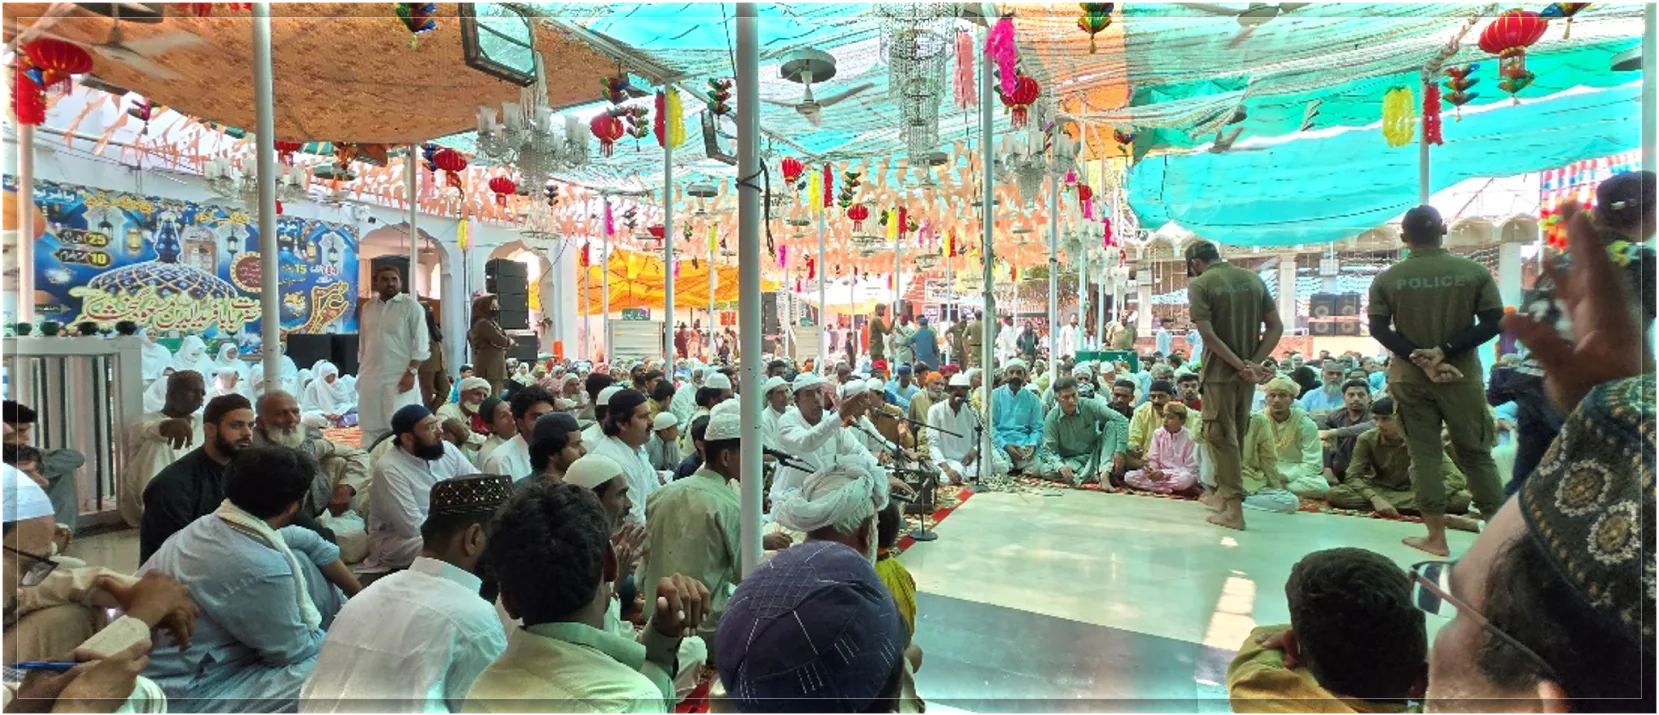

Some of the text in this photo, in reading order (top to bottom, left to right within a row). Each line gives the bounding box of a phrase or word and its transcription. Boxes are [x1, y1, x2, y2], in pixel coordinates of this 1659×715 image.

[88, 233, 107, 245] 25
[91, 252, 107, 265] 10
[1396, 275, 1466, 290] POLICE
